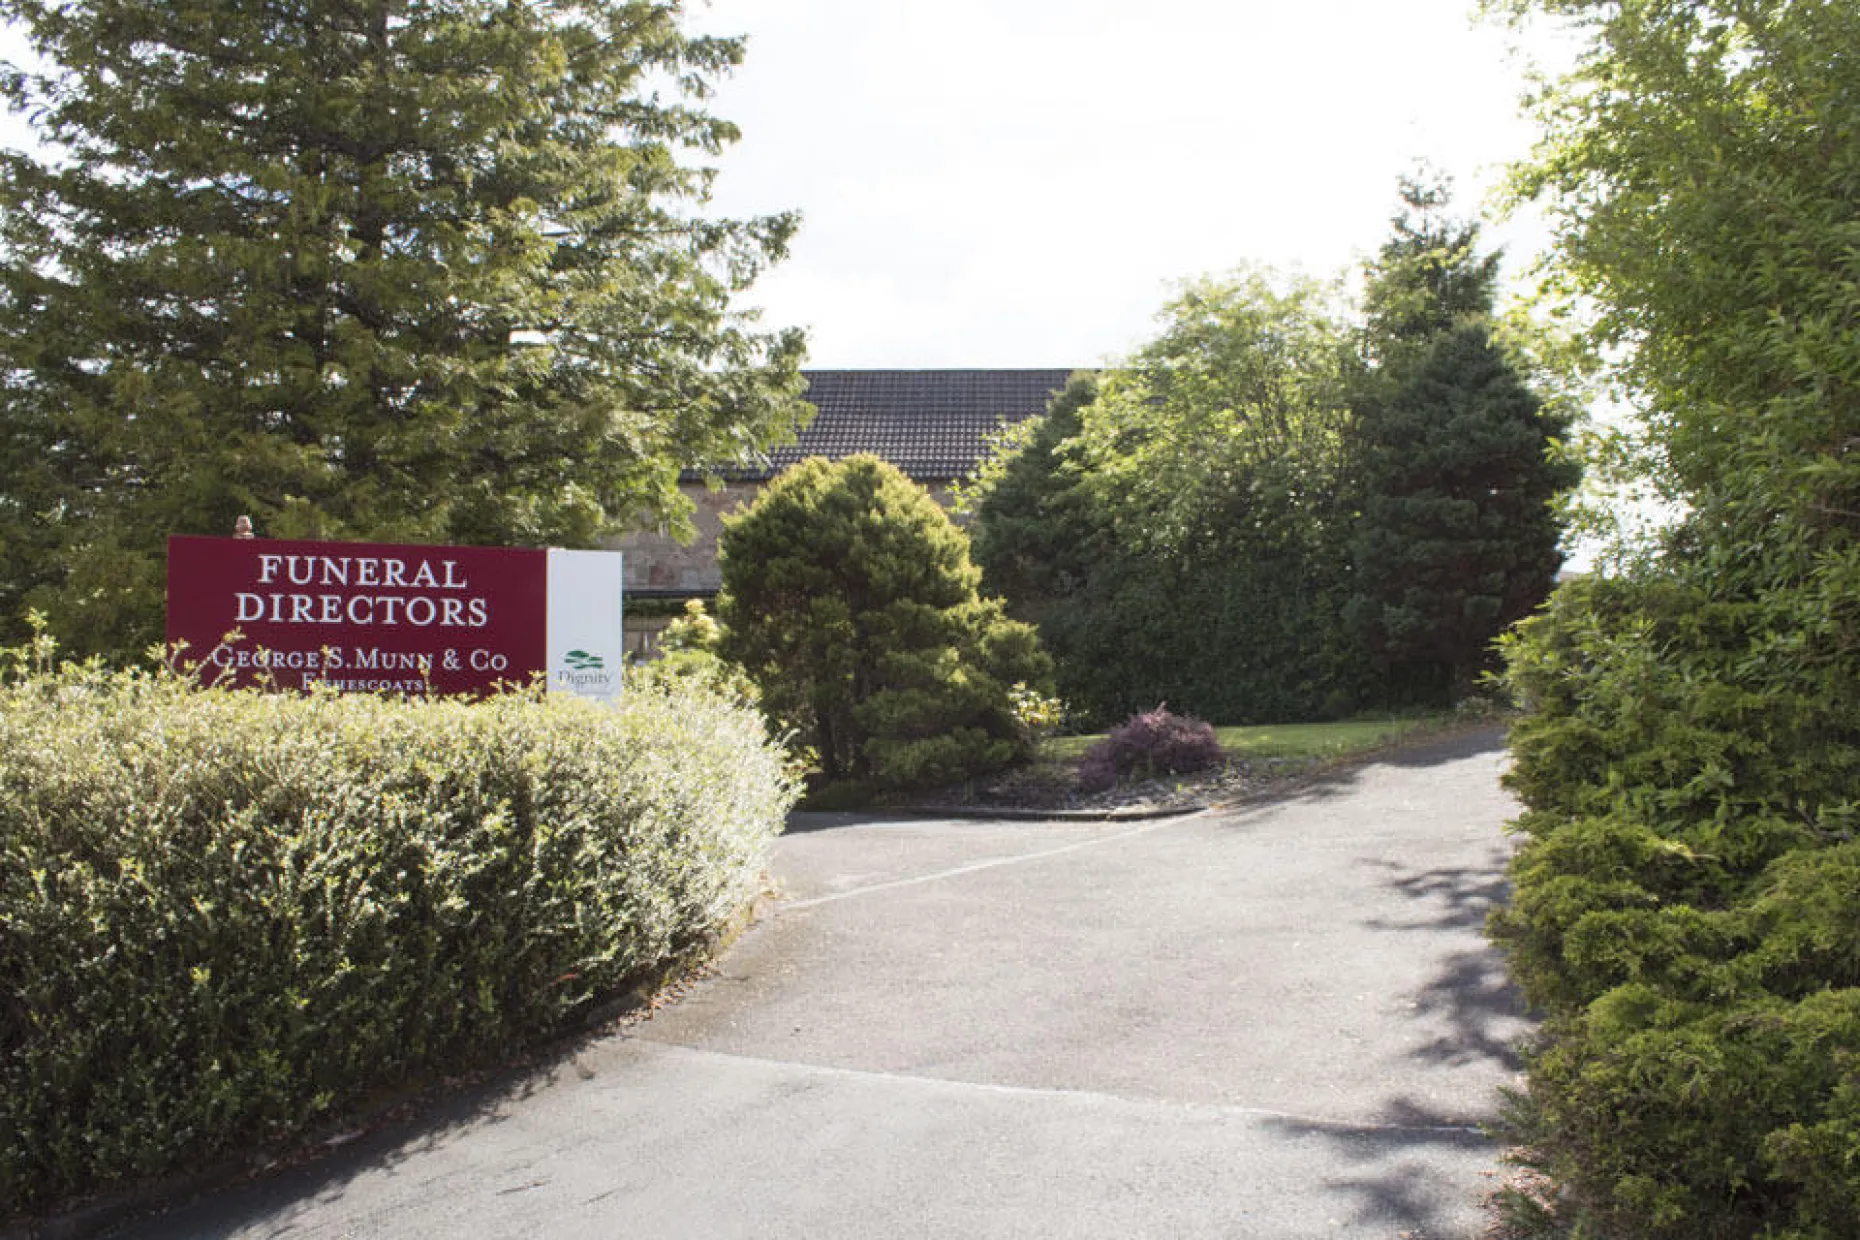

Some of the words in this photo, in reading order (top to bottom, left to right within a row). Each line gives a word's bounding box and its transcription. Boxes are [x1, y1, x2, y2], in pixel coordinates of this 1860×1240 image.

[257, 553, 468, 588] FUNERAL
[233, 592, 488, 627] DIRECTORS
[442, 648, 463, 671] &
[558, 669, 613, 689] Dignity
